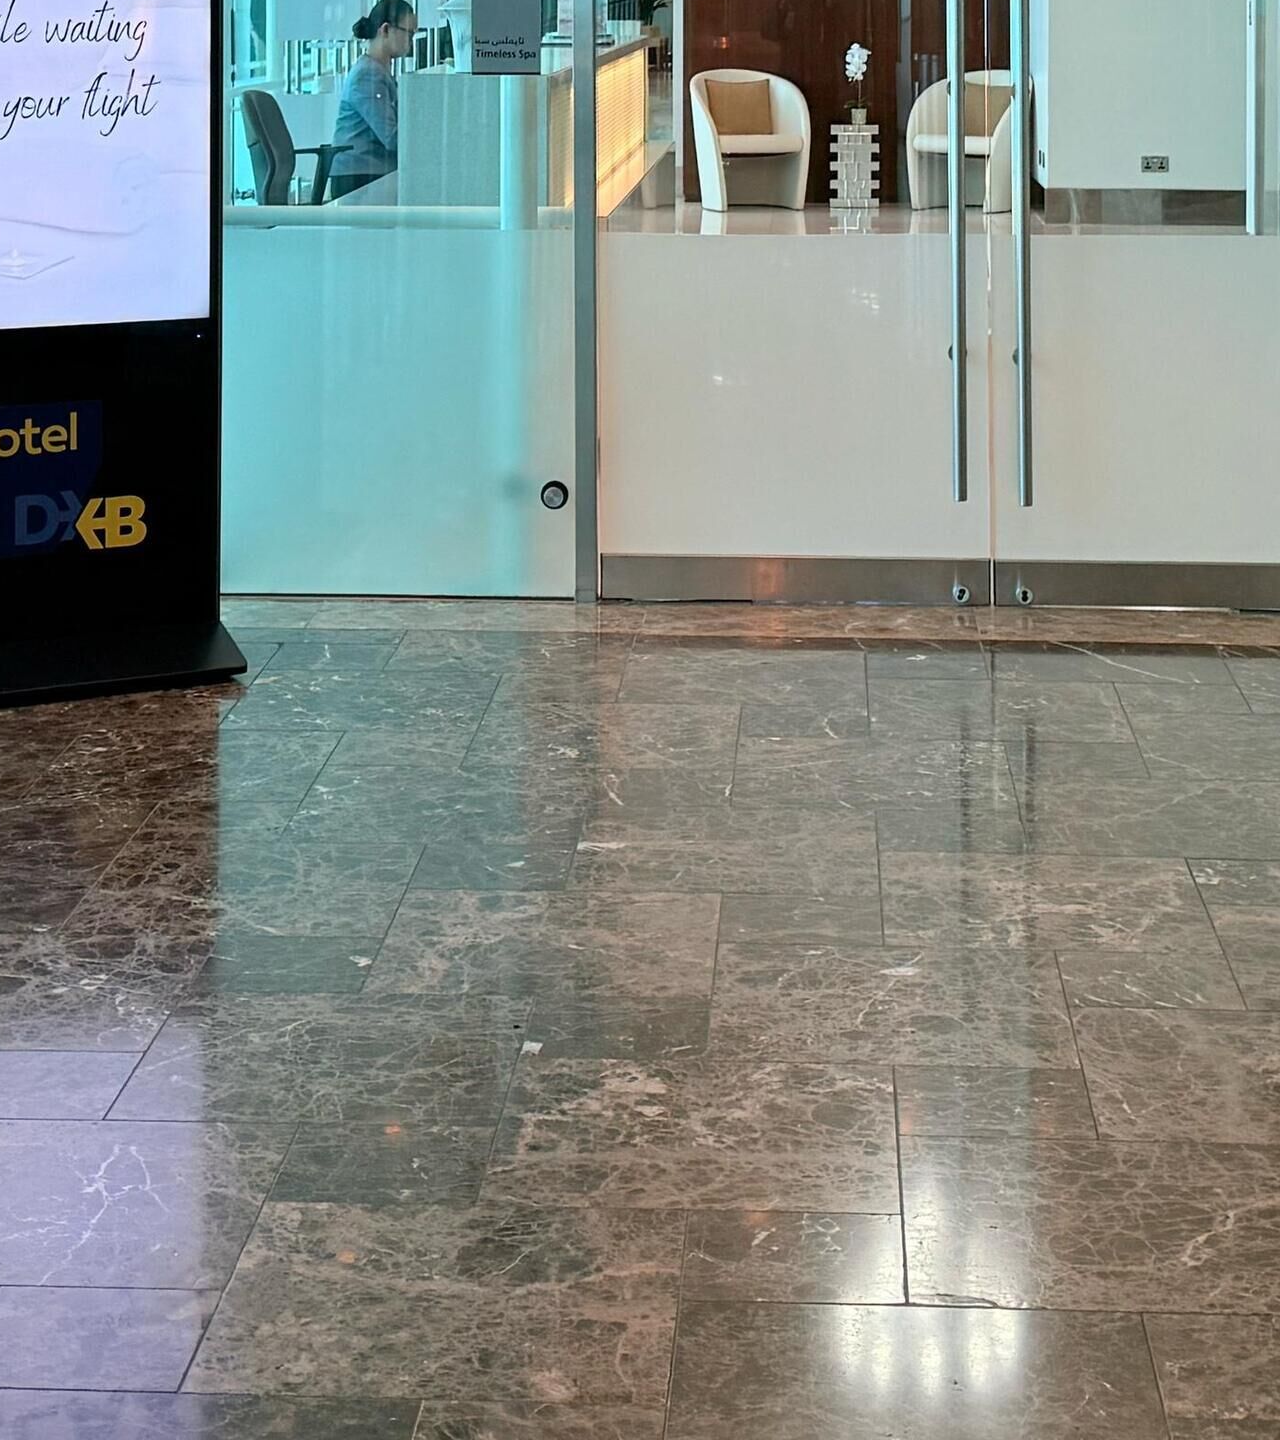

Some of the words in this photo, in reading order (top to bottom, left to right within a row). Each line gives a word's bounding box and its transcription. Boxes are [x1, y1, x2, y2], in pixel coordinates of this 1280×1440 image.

[45, 0, 148, 62] waiting
[475, 49, 516, 58] Timeless
[518, 48, 537, 60] Spa
[0, 96, 70, 140] your
[82, 68, 160, 137] flight
[14, 490, 147, 550] DXB
